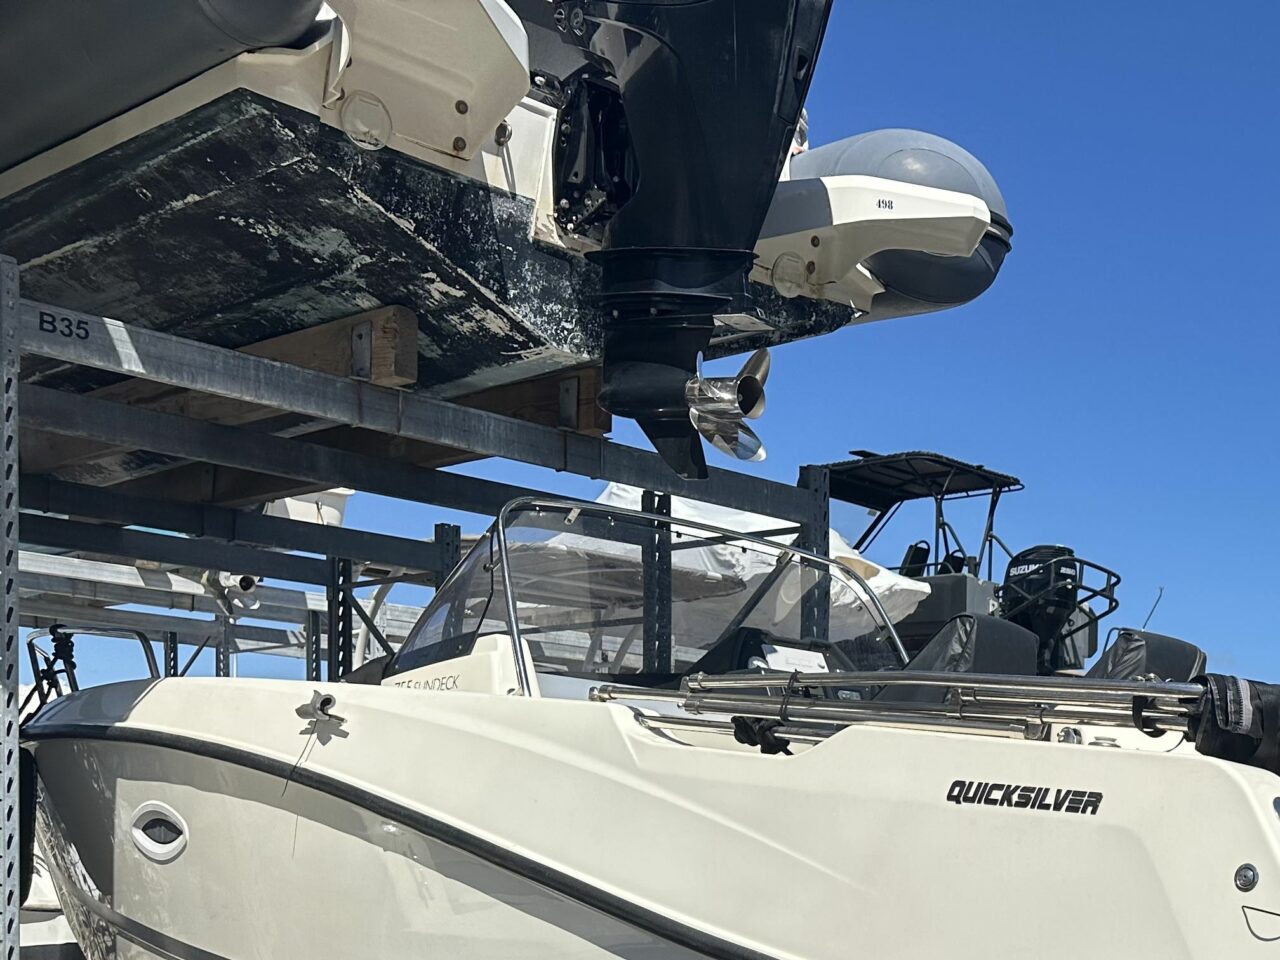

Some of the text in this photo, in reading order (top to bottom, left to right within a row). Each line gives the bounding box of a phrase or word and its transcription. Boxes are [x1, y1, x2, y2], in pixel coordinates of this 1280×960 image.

[875, 199, 894, 210] 498
[39, 311, 90, 340] B35
[946, 780, 1104, 816] QUICKSILVER
